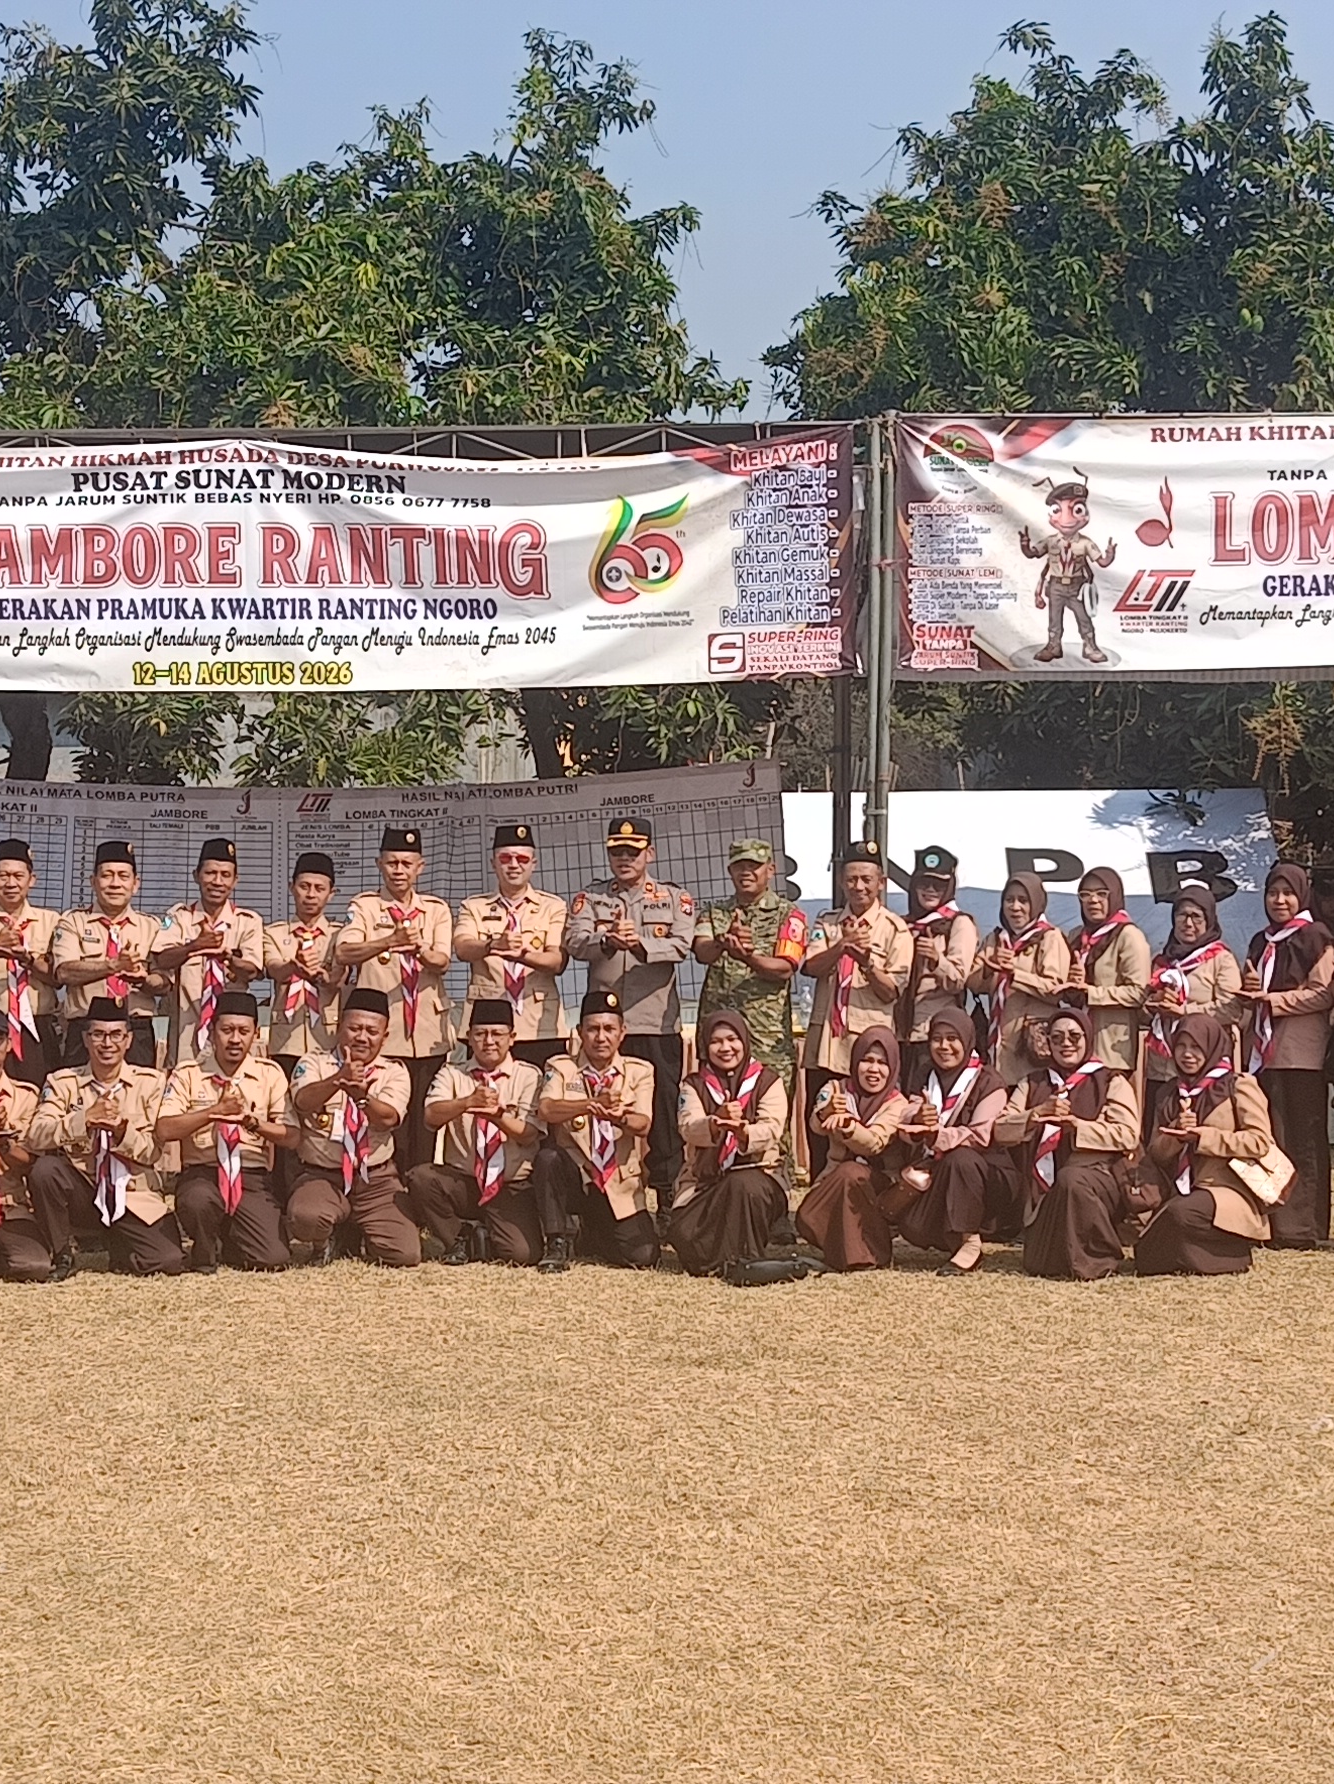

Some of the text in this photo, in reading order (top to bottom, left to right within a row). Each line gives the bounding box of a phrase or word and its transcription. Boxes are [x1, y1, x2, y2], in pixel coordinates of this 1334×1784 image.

[1151, 426, 1242, 443] RUMAH
[71, 450, 173, 467] HIKMAH
[178, 448, 279, 465] HUSADA
[288, 452, 358, 469] DESA
[71, 468, 406, 494] PUSAT SUNAT MODERN
[754, 472, 795, 488] Khitan
[1267, 469, 1327, 481] TANPA
[56, 494, 116, 506] JARUM
[122, 493, 186, 505] SUNTIK
[195, 492, 253, 504] BEBAS
[260, 493, 312, 505] NYERI
[351, 494, 395, 506] 0856
[402, 497, 444, 508] 0677
[452, 497, 491, 508] 7758
[747, 487, 826, 508] Khitan Anak
[732, 508, 826, 528] Khitan Dewasa
[747, 526, 827, 545] Khitan Autis
[258, 519, 551, 600] RANTING
[734, 546, 827, 565] Khitan Gemuk
[737, 565, 828, 584] Khitan Massal
[740, 586, 828, 607] Repair Khitan
[97, 598, 206, 620] PRAMUKA
[211, 598, 313, 620] KWARTIR
[318, 598, 417, 620] RANTING
[423, 598, 498, 620] NGORO
[722, 606, 829, 624] Pelatihan Khitan
[1199, 605, 1293, 627] Memantapkan
[748, 629, 839, 643] SUPER-RING
[916, 624, 975, 639] SUNAT
[12, 627, 70, 657] Langkah
[75, 627, 141, 656] Organisasi
[144, 627, 221, 656] Mendukung
[225, 626, 304, 652] Swasembada
[308, 627, 359, 655] Pangan
[362, 627, 413, 655] Menuju
[418, 627, 480, 647] Indonesia
[481, 626, 520, 655] Emas
[524, 626, 557, 645] 2045
[924, 640, 965, 651] TANPA
[195, 661, 294, 685] AGUSTUS
[299, 661, 353, 685] 2026
[47, 787, 82, 798] MATA
[86, 789, 136, 801] LOMBA
[140, 791, 186, 803] PUTRA
[401, 791, 441, 803] HASIL
[537, 784, 579, 795] PUTRI
[599, 794, 655, 807] JAMBORE
[150, 808, 209, 819] JAMBORE
[345, 809, 386, 820] LOMBA
[389, 807, 440, 818] TINGKAT
[643, 902, 671, 911] POLRI
